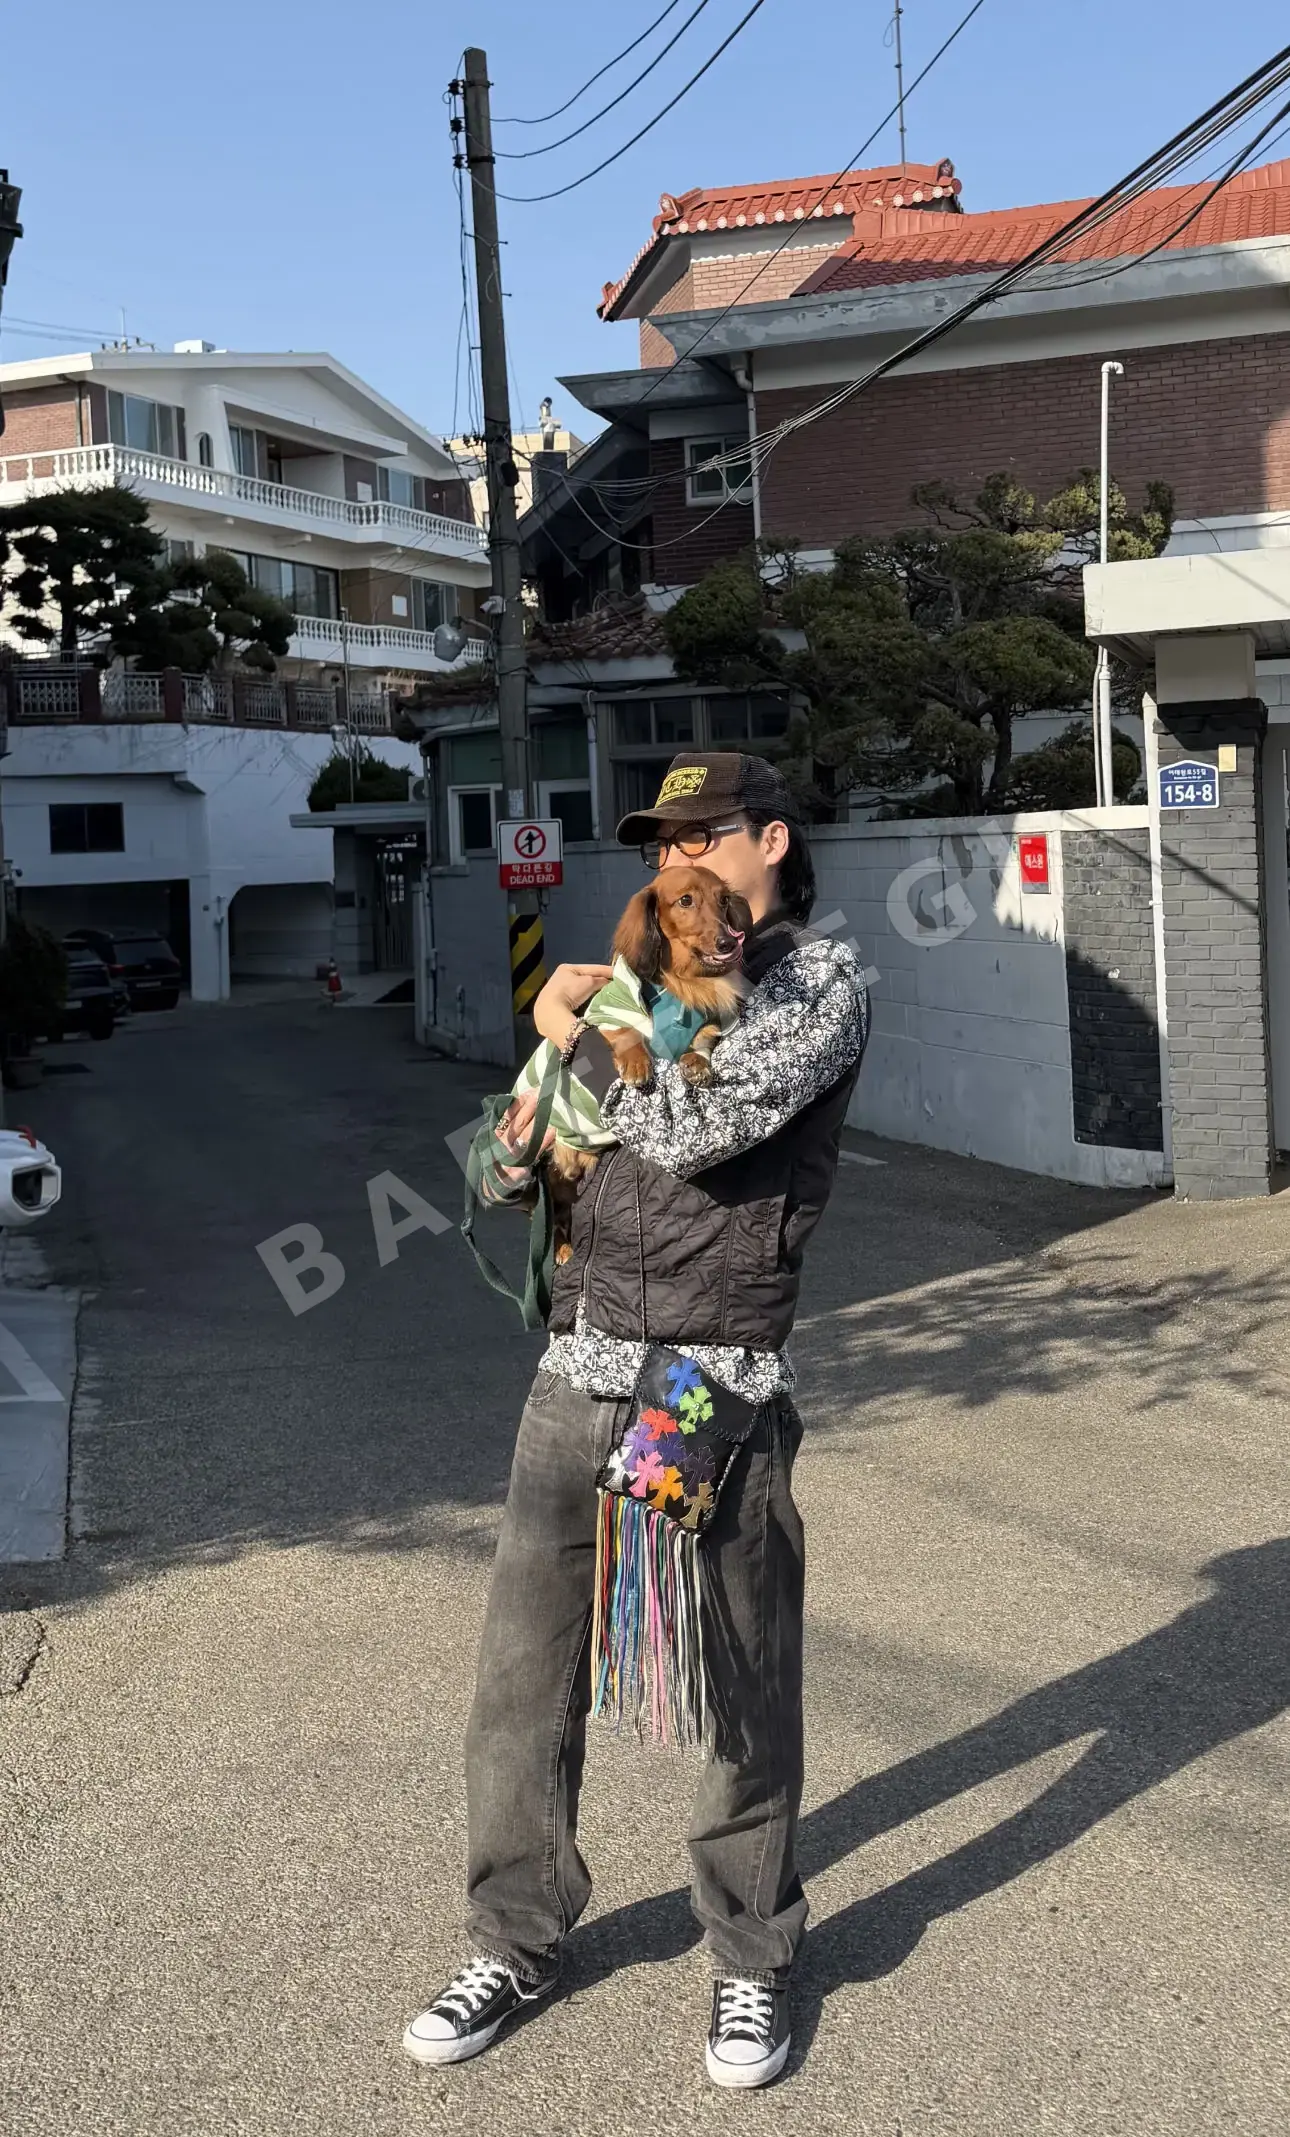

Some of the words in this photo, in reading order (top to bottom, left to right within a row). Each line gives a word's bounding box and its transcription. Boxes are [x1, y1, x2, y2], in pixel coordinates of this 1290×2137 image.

[1164, 783, 1213, 803] 154-8
[510, 875, 534, 885] DEAD
[536, 873, 555, 883] END
